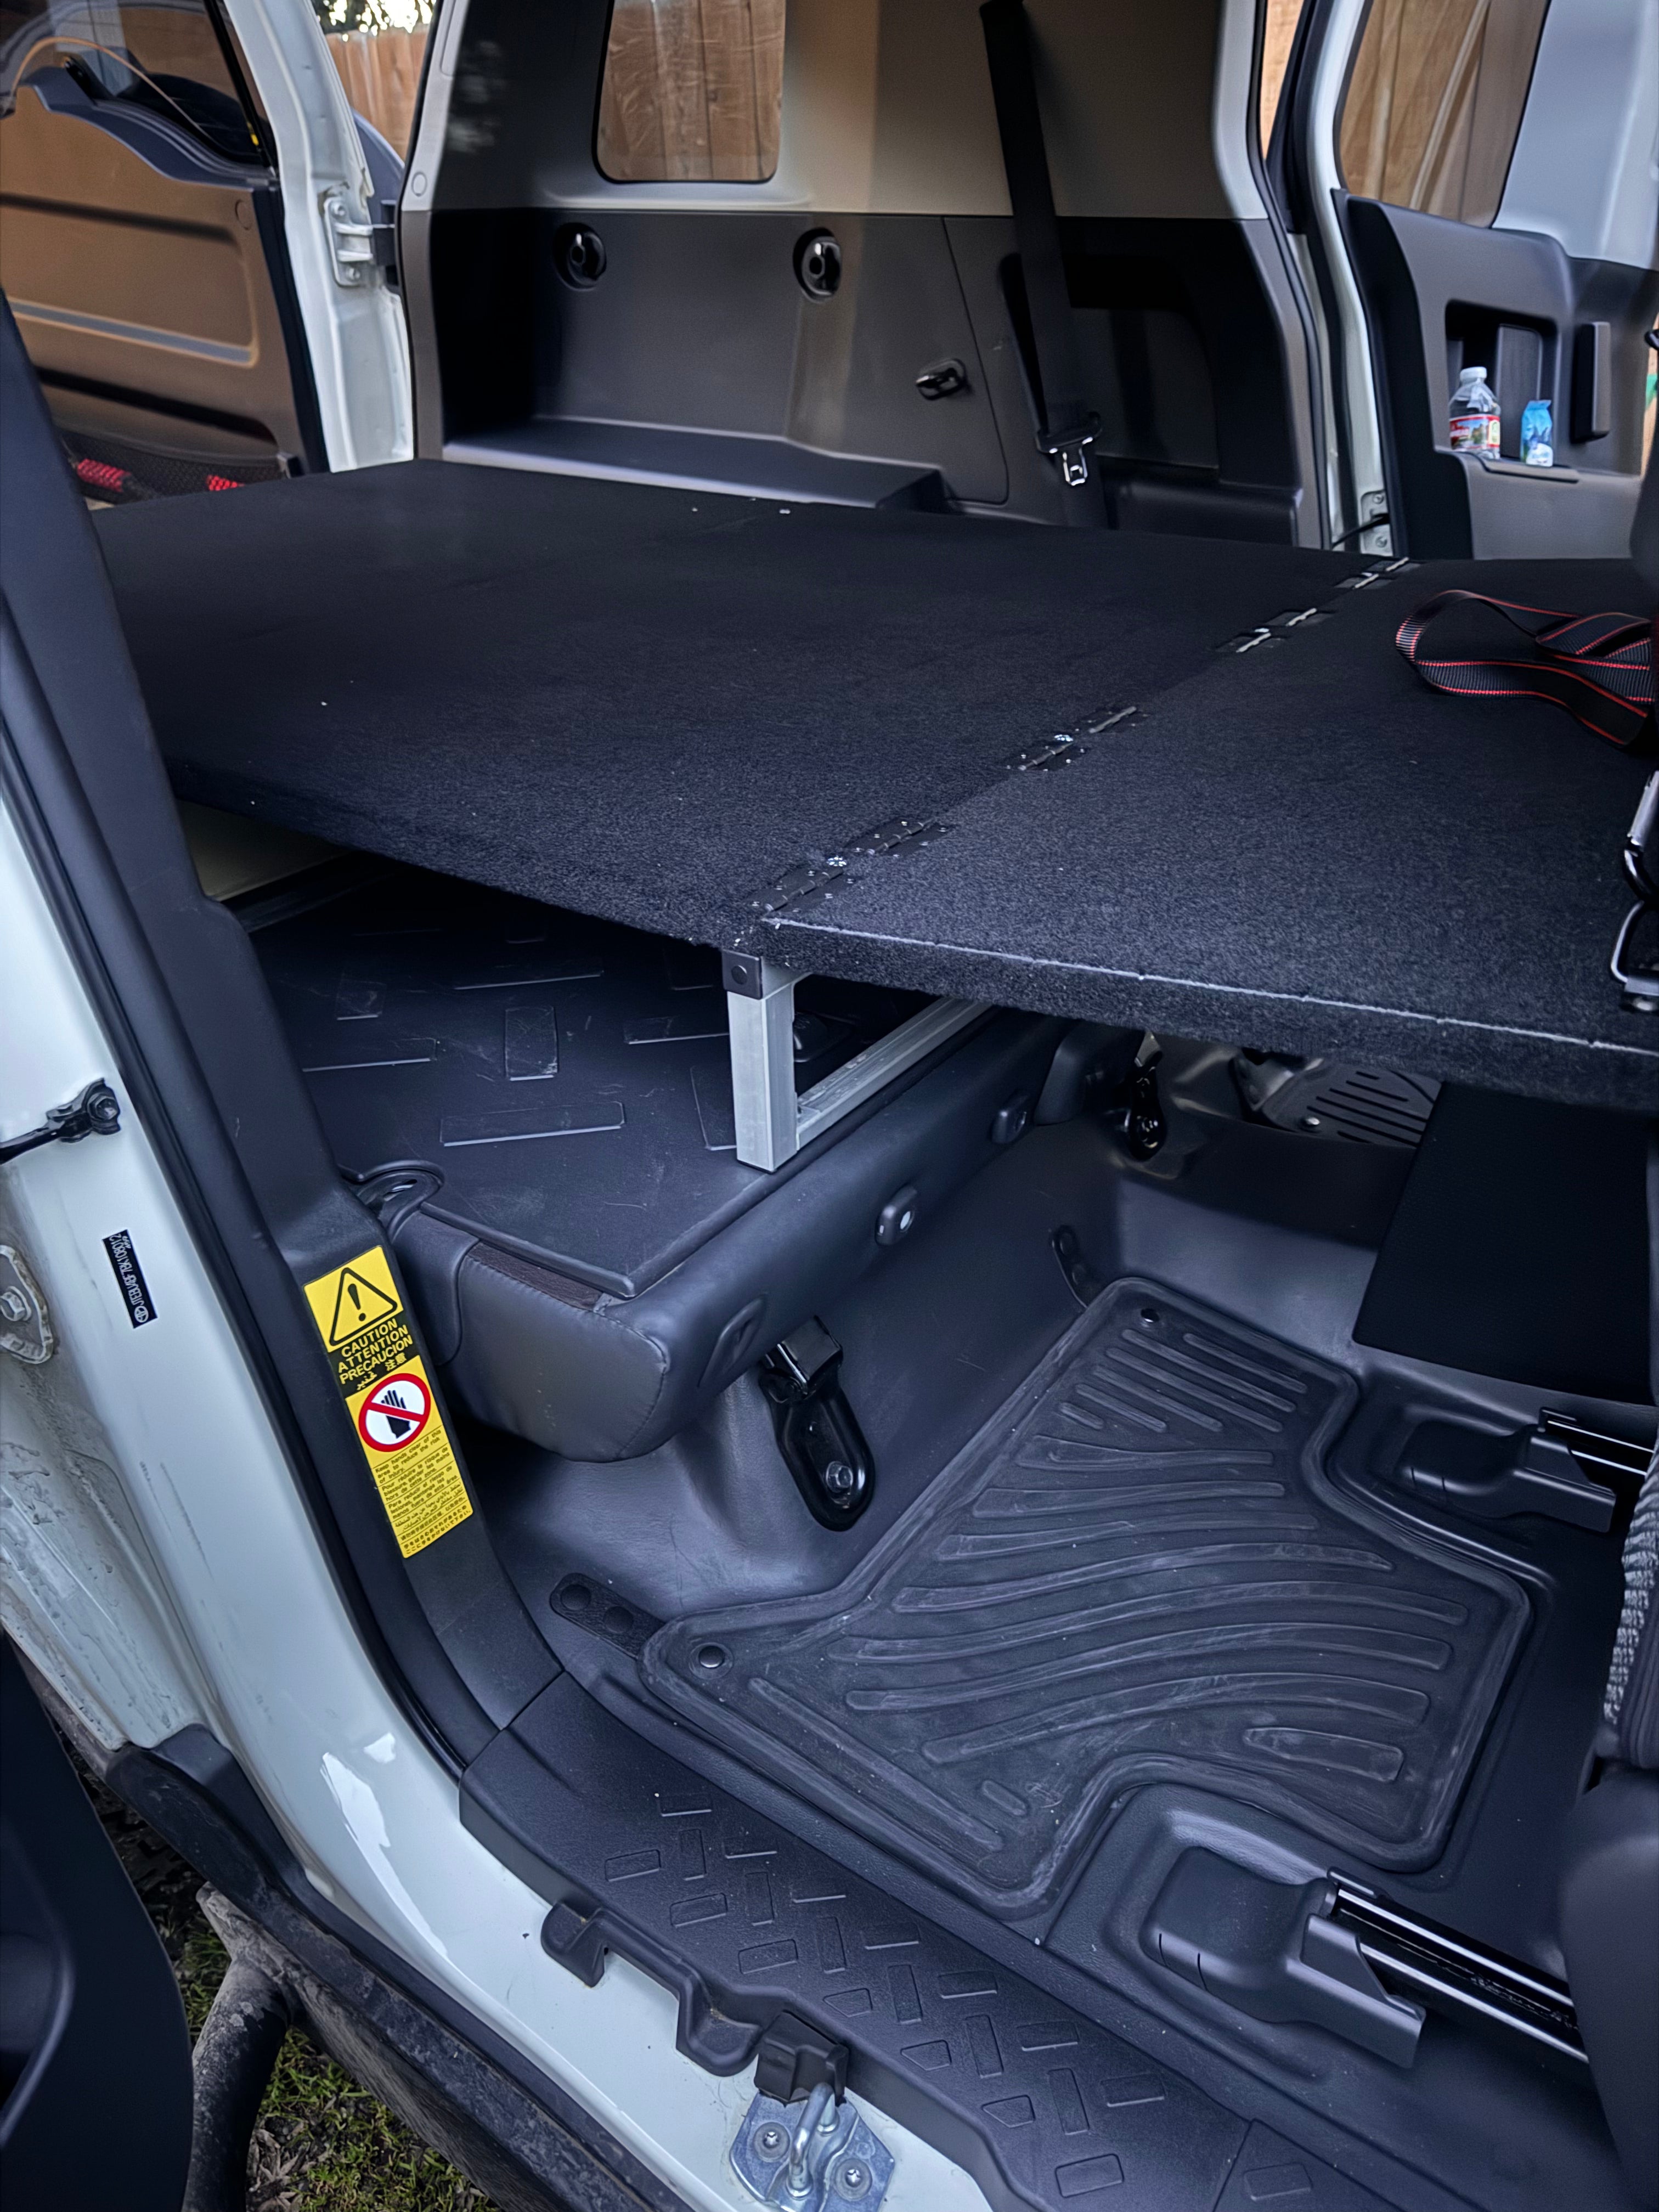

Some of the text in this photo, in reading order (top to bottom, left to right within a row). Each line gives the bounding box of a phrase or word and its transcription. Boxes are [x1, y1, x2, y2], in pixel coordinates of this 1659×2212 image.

[338, 1325, 408, 1373] ATTENTION
[342, 1318, 397, 1357] CAUTION
[339, 1335, 413, 1384] PRECAUCION
[385, 1352, 407, 1371] 注意
